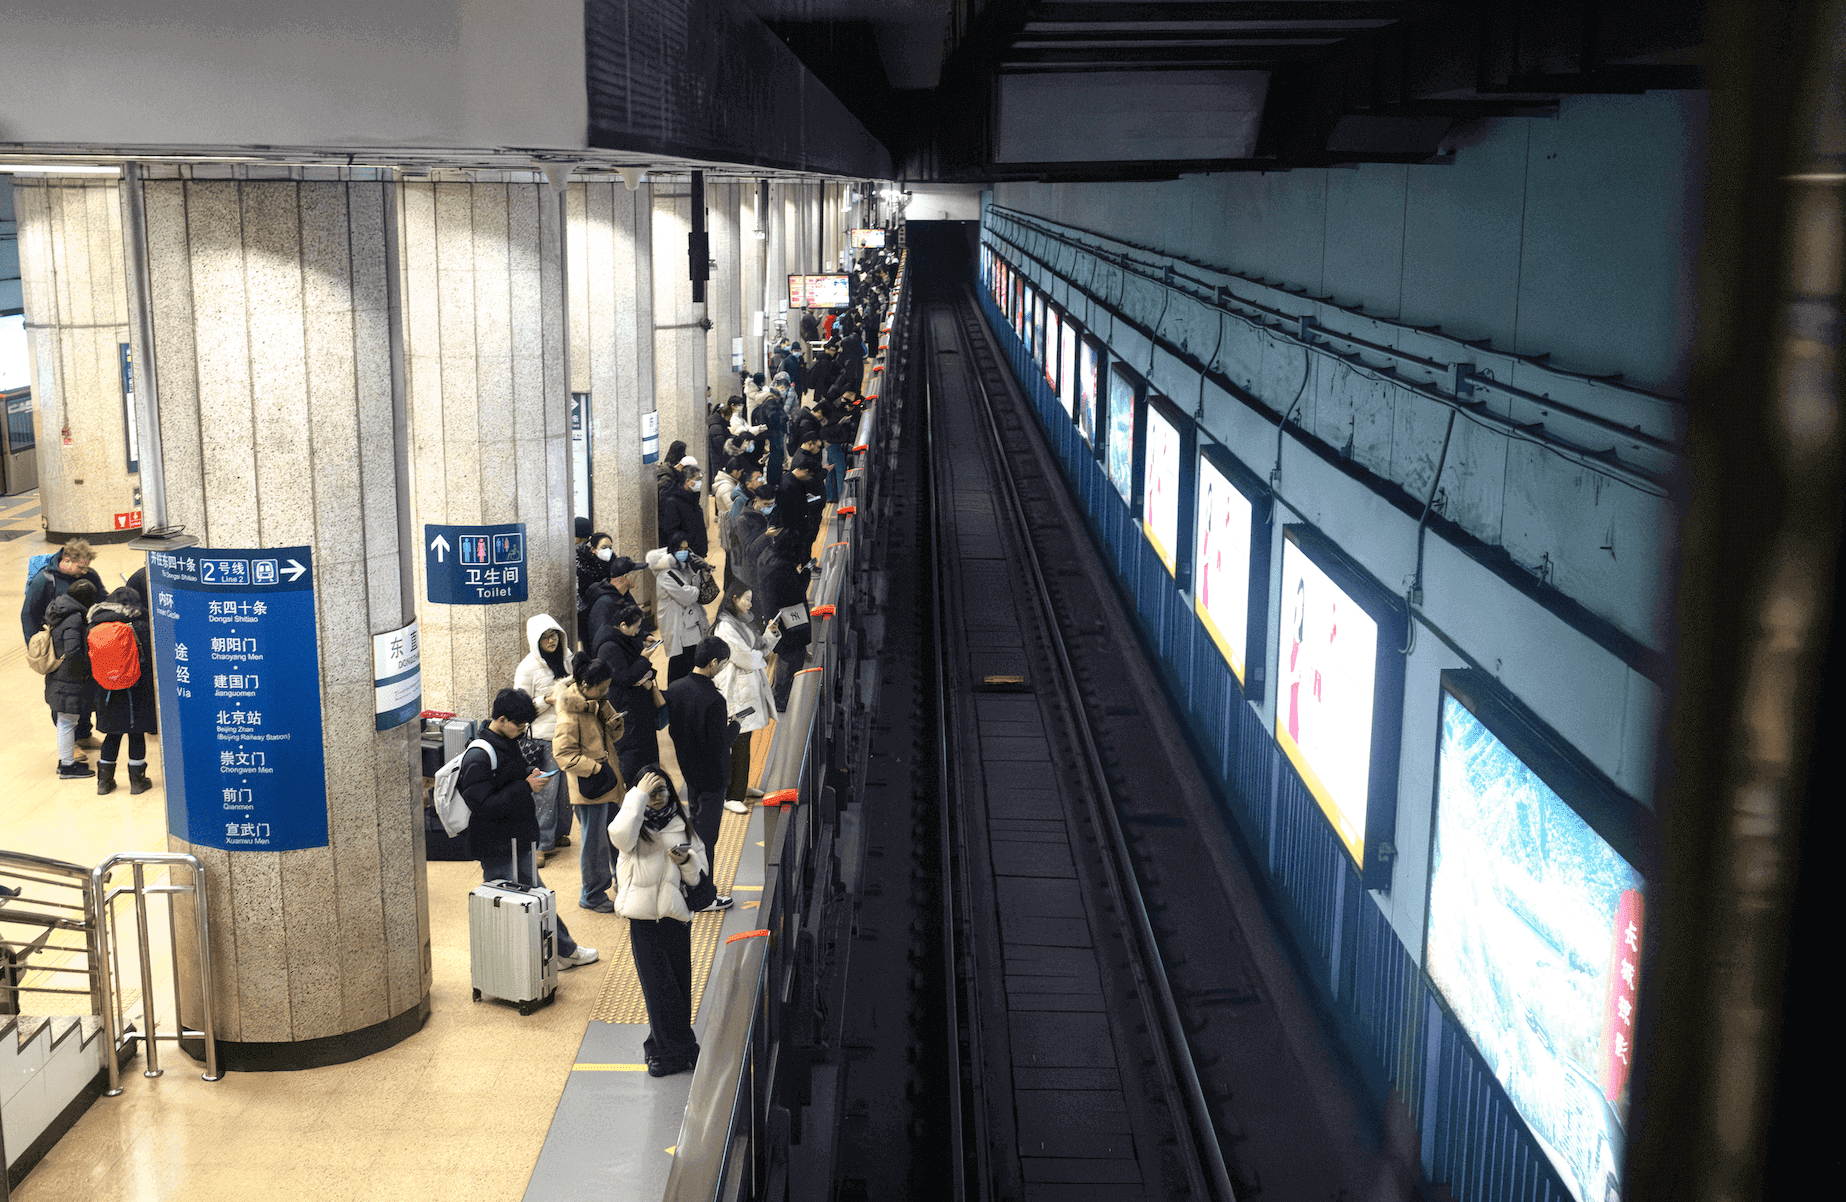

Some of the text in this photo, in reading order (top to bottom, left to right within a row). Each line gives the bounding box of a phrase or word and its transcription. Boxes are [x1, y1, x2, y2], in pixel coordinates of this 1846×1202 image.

[203, 562, 245, 581] 2号线
[465, 566, 519, 586] 卫生间
[238, 575, 244, 583] 2
[476, 586, 512, 598] Toilet
[208, 600, 268, 615] 东四十条
[208, 615, 259, 624] Dongsi Shitiao
[210, 637, 257, 652] 朝阳门
[175, 642, 190, 684] 途经
[211, 652, 264, 662] Chaoyang Men
[213, 674, 260, 689] 建国门
[176, 686, 191, 698] Via
[214, 689, 256, 698] Jianguomen
[216, 710, 262, 725] 北京站
[216, 725, 238, 734] Beijing
[216, 732, 291, 742] (Beijing Railway Station)
[220, 751, 265, 766] 崇文门
[220, 766, 274, 775] Chongwen Men
[222, 787, 253, 803] 前门
[223, 803, 255, 811] Qianmen
[225, 822, 271, 837] 宣武门
[225, 837, 271, 845] Xuanwu Men
